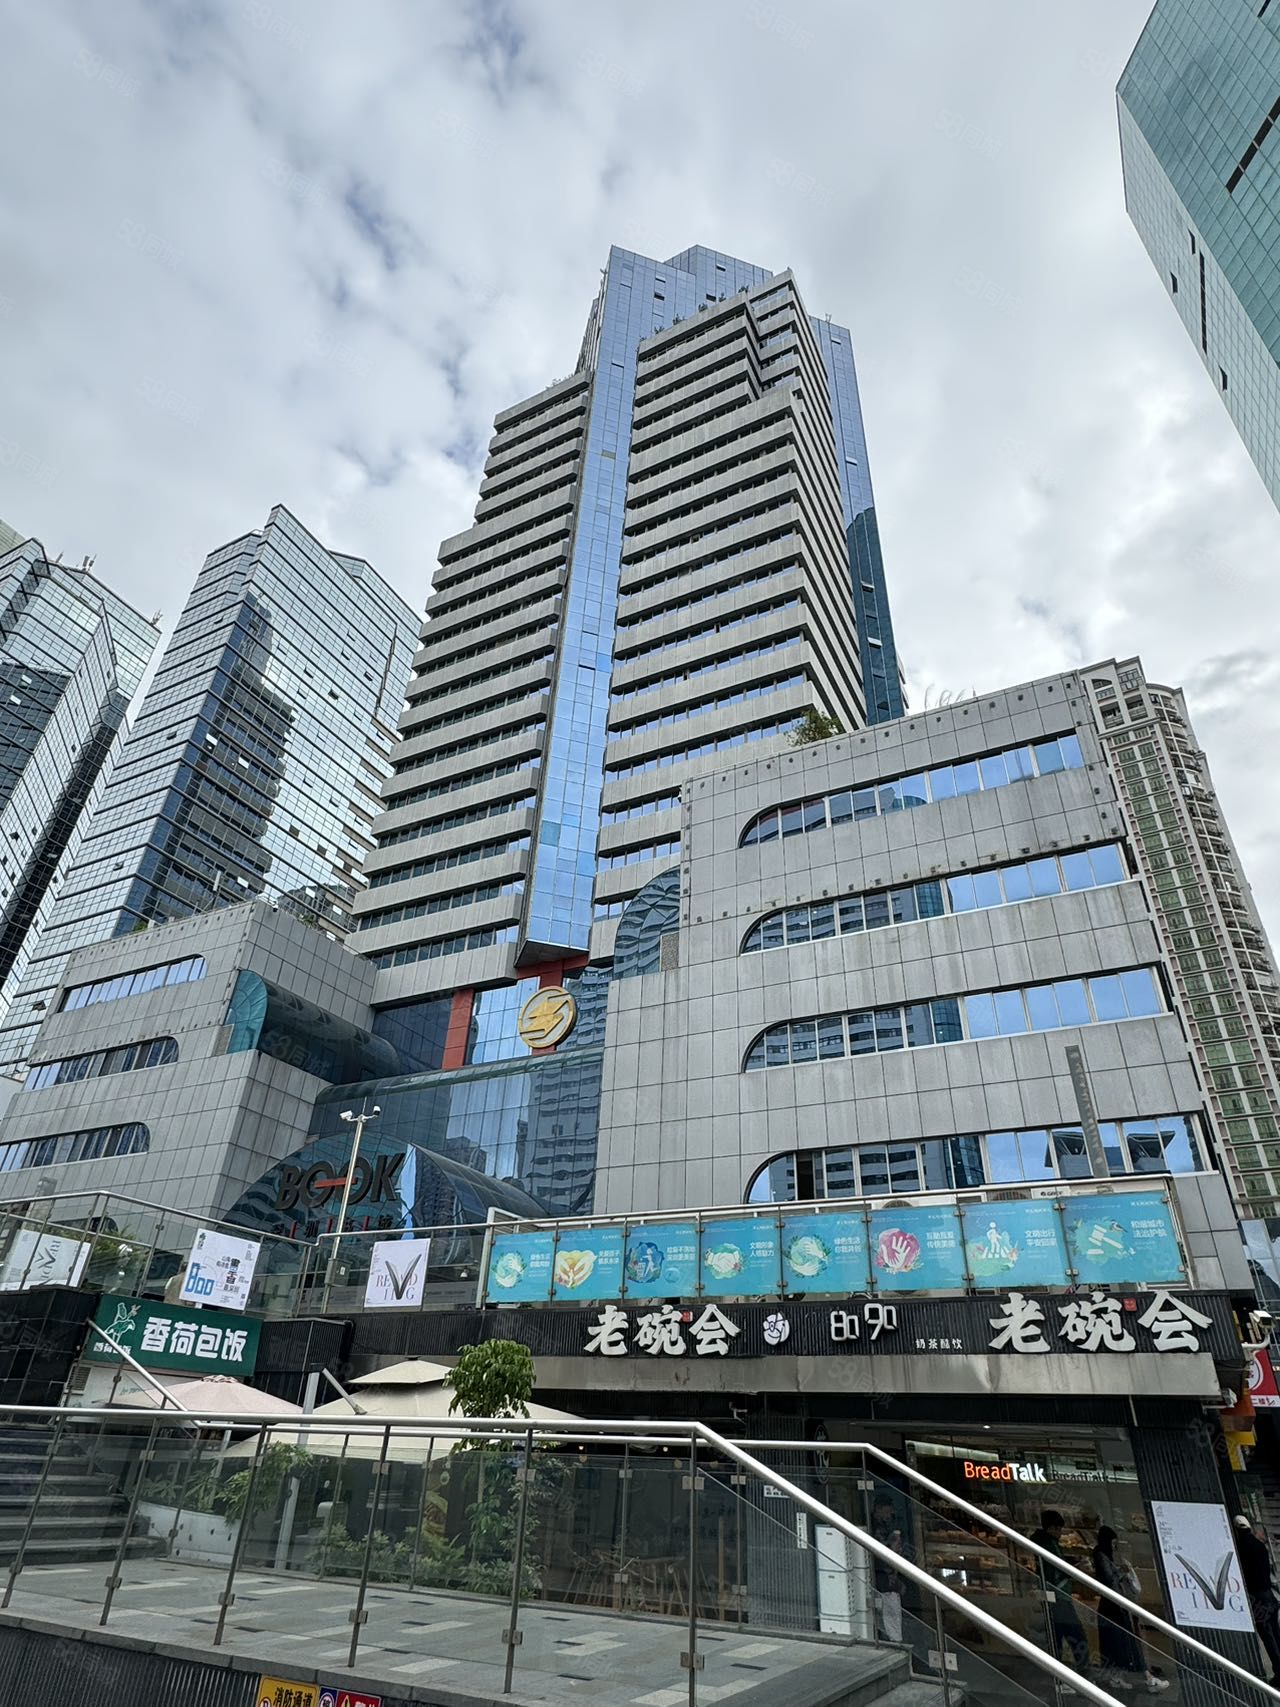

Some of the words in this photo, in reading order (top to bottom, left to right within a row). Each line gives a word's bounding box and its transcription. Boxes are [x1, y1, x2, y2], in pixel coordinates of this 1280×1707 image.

[275, 1152, 406, 1210] BOOK
[140, 1316, 248, 1362] 香荷包饭
[584, 1304, 741, 1355] 老碗会
[988, 1290, 1213, 1353] 老碗会
[964, 1461, 1047, 1483] BreadTalk
